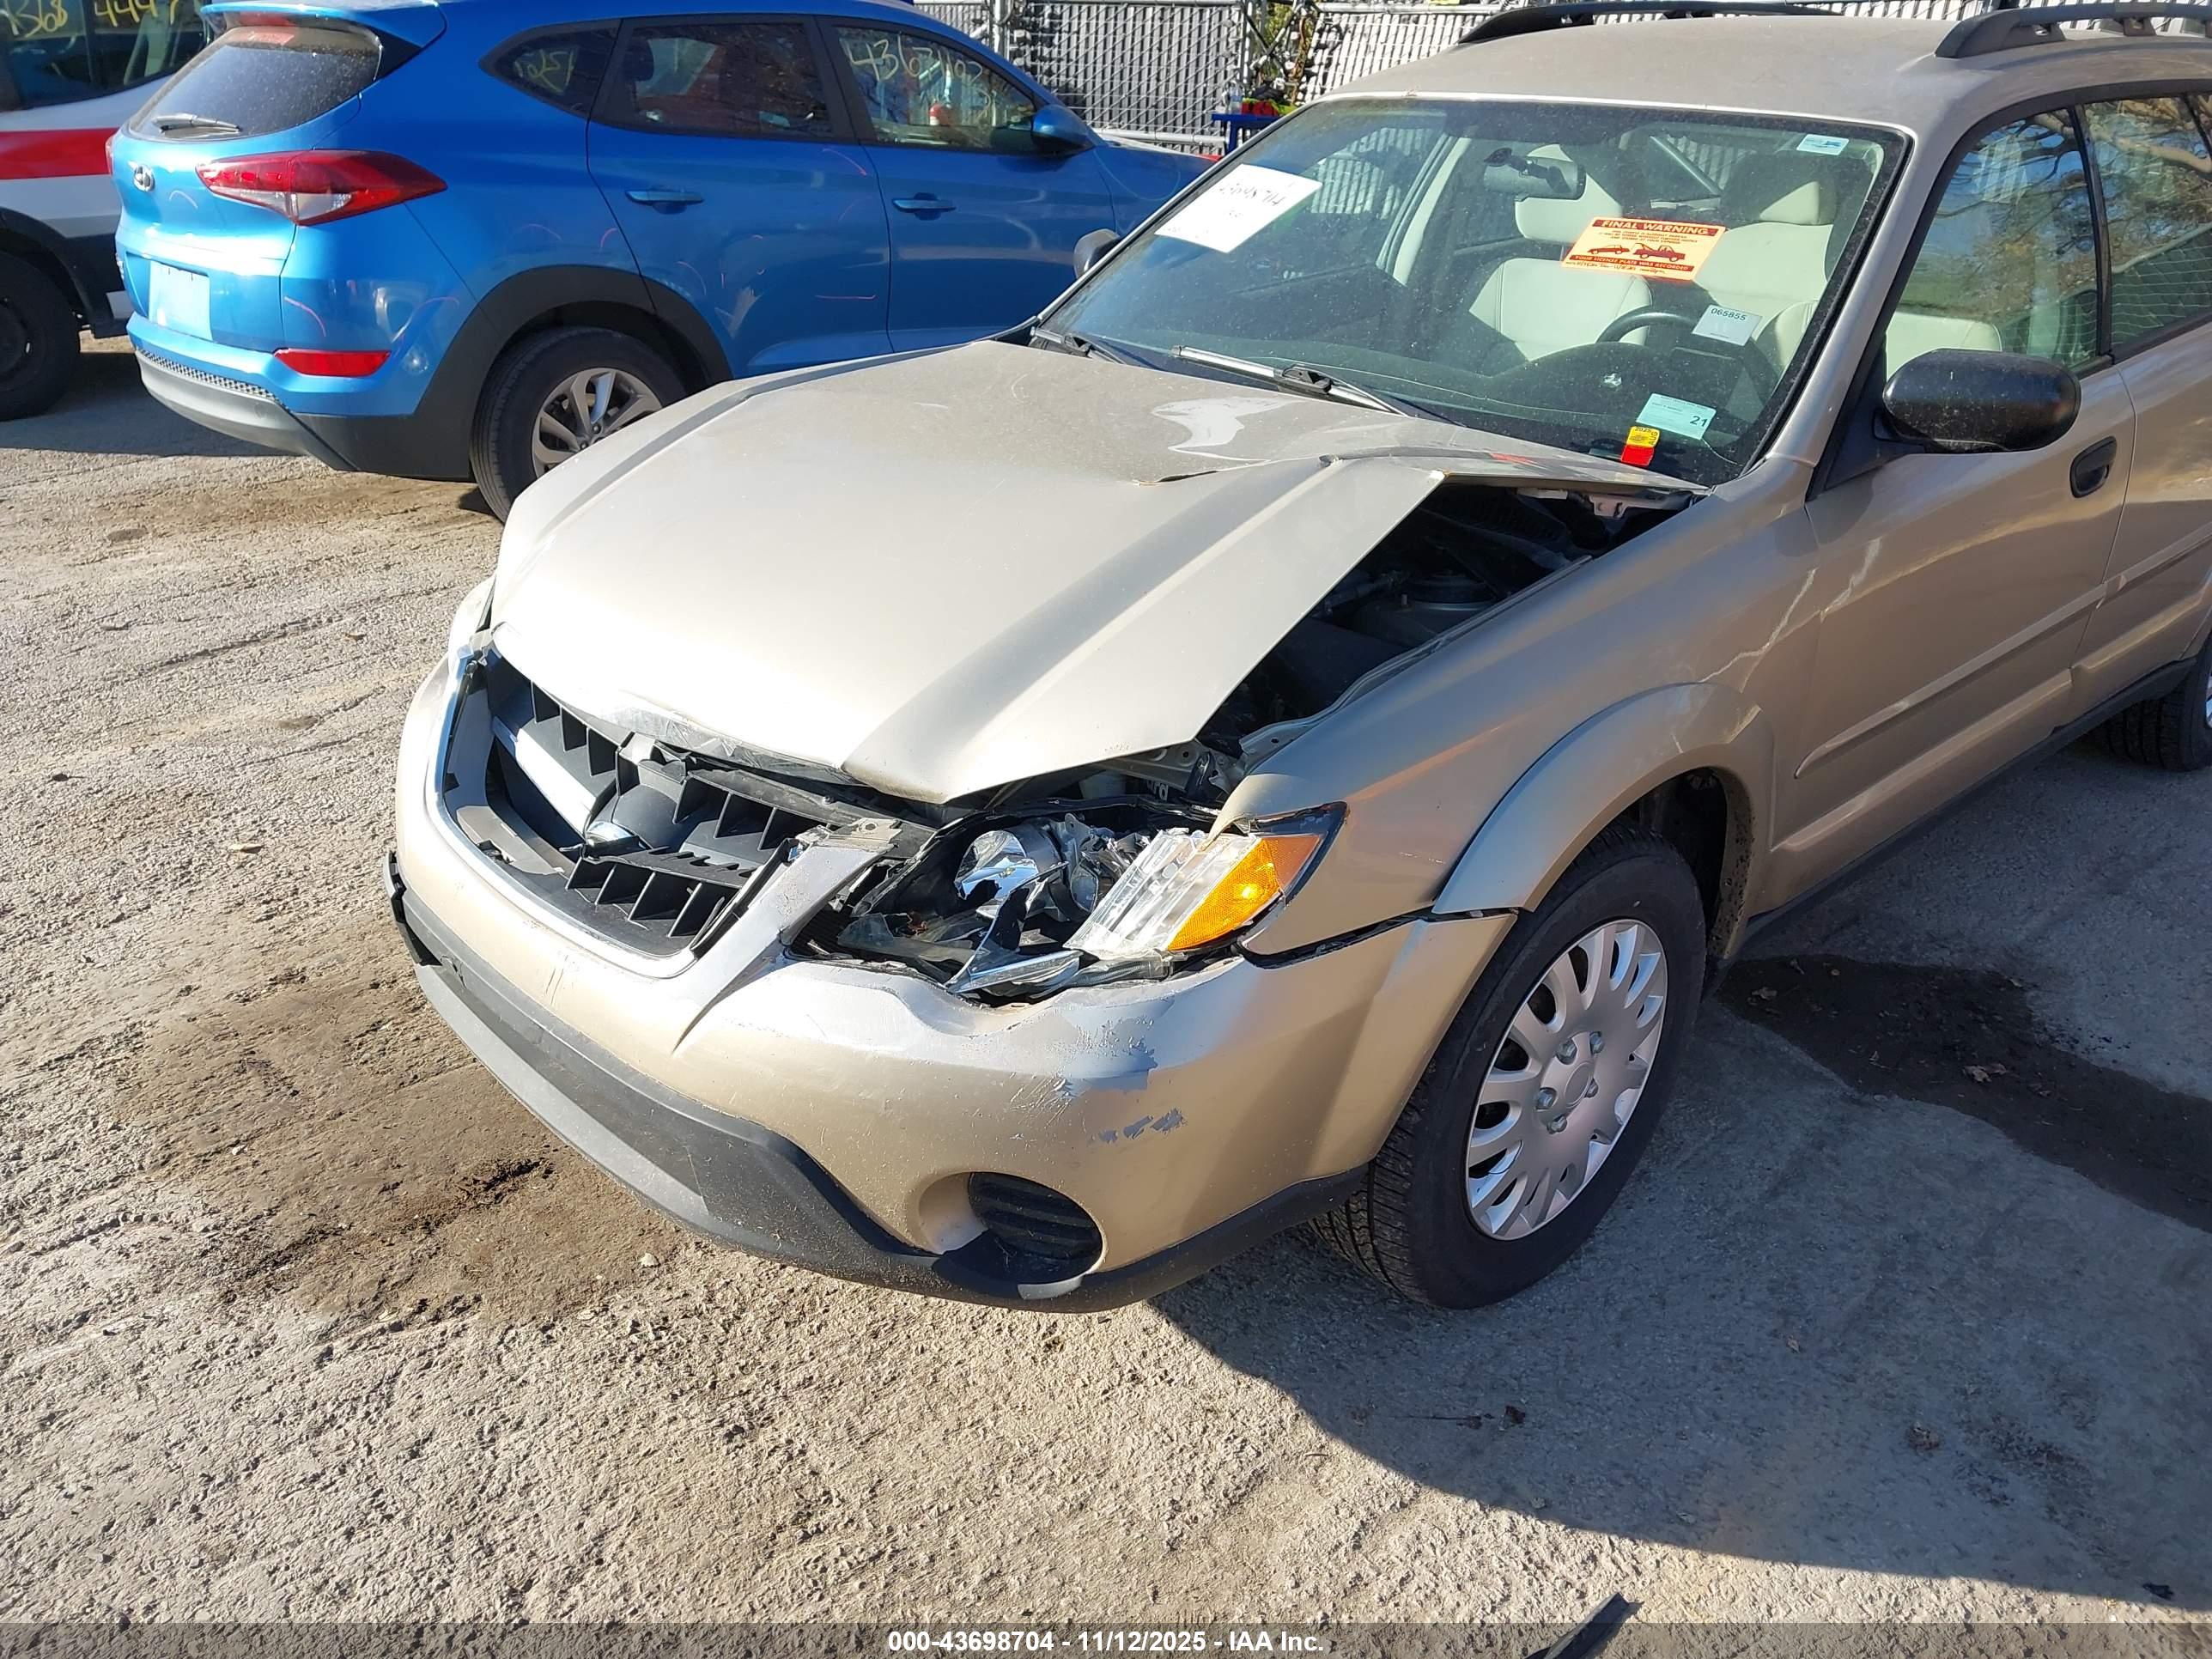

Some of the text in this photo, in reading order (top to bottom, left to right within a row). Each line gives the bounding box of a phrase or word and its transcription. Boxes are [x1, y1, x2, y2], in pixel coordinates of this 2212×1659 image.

[1601, 220, 1638, 229] FINAL
[1644, 222, 1709, 235] WARNING
[1711, 307, 1747, 321] 065855
[1689, 415, 1709, 428] 21
